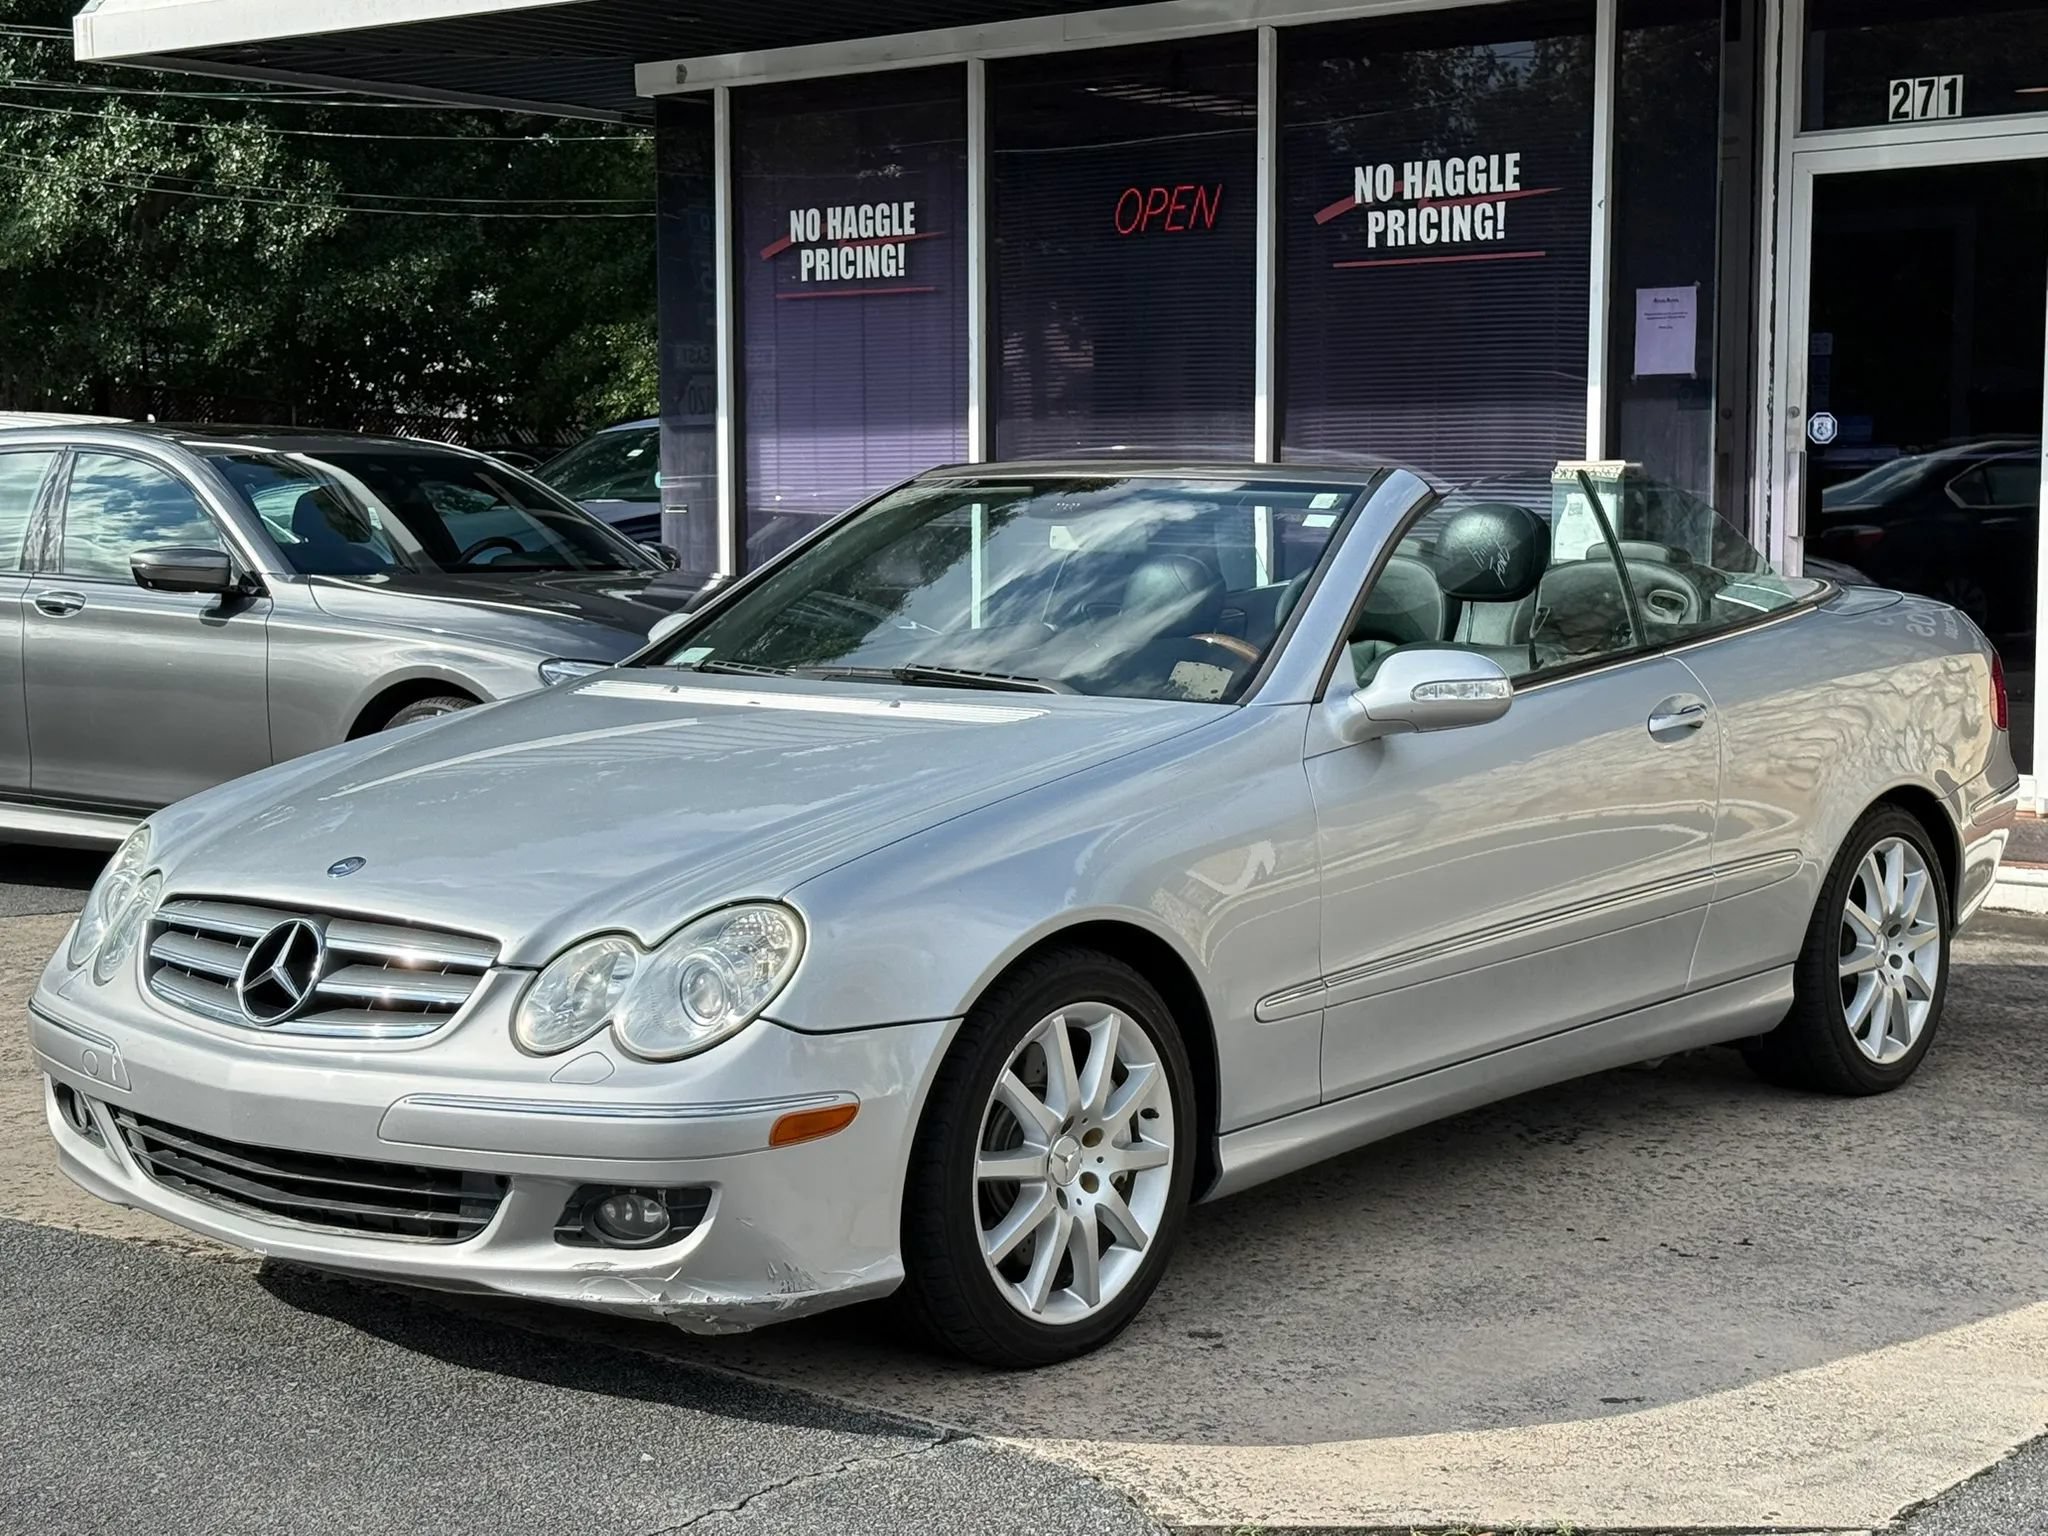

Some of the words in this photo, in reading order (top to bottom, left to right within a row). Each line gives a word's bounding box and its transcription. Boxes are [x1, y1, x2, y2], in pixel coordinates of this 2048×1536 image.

[1891, 77, 1958, 120] 271
[1354, 163, 1395, 205] NO
[1403, 152, 1521, 201] HAGGLE
[790, 208, 820, 243] NO
[827, 201, 916, 241] HAGGLE
[1115, 183, 1223, 235] OPEN
[1367, 201, 1506, 249] PRICING!
[800, 243, 905, 282] PRICING!
